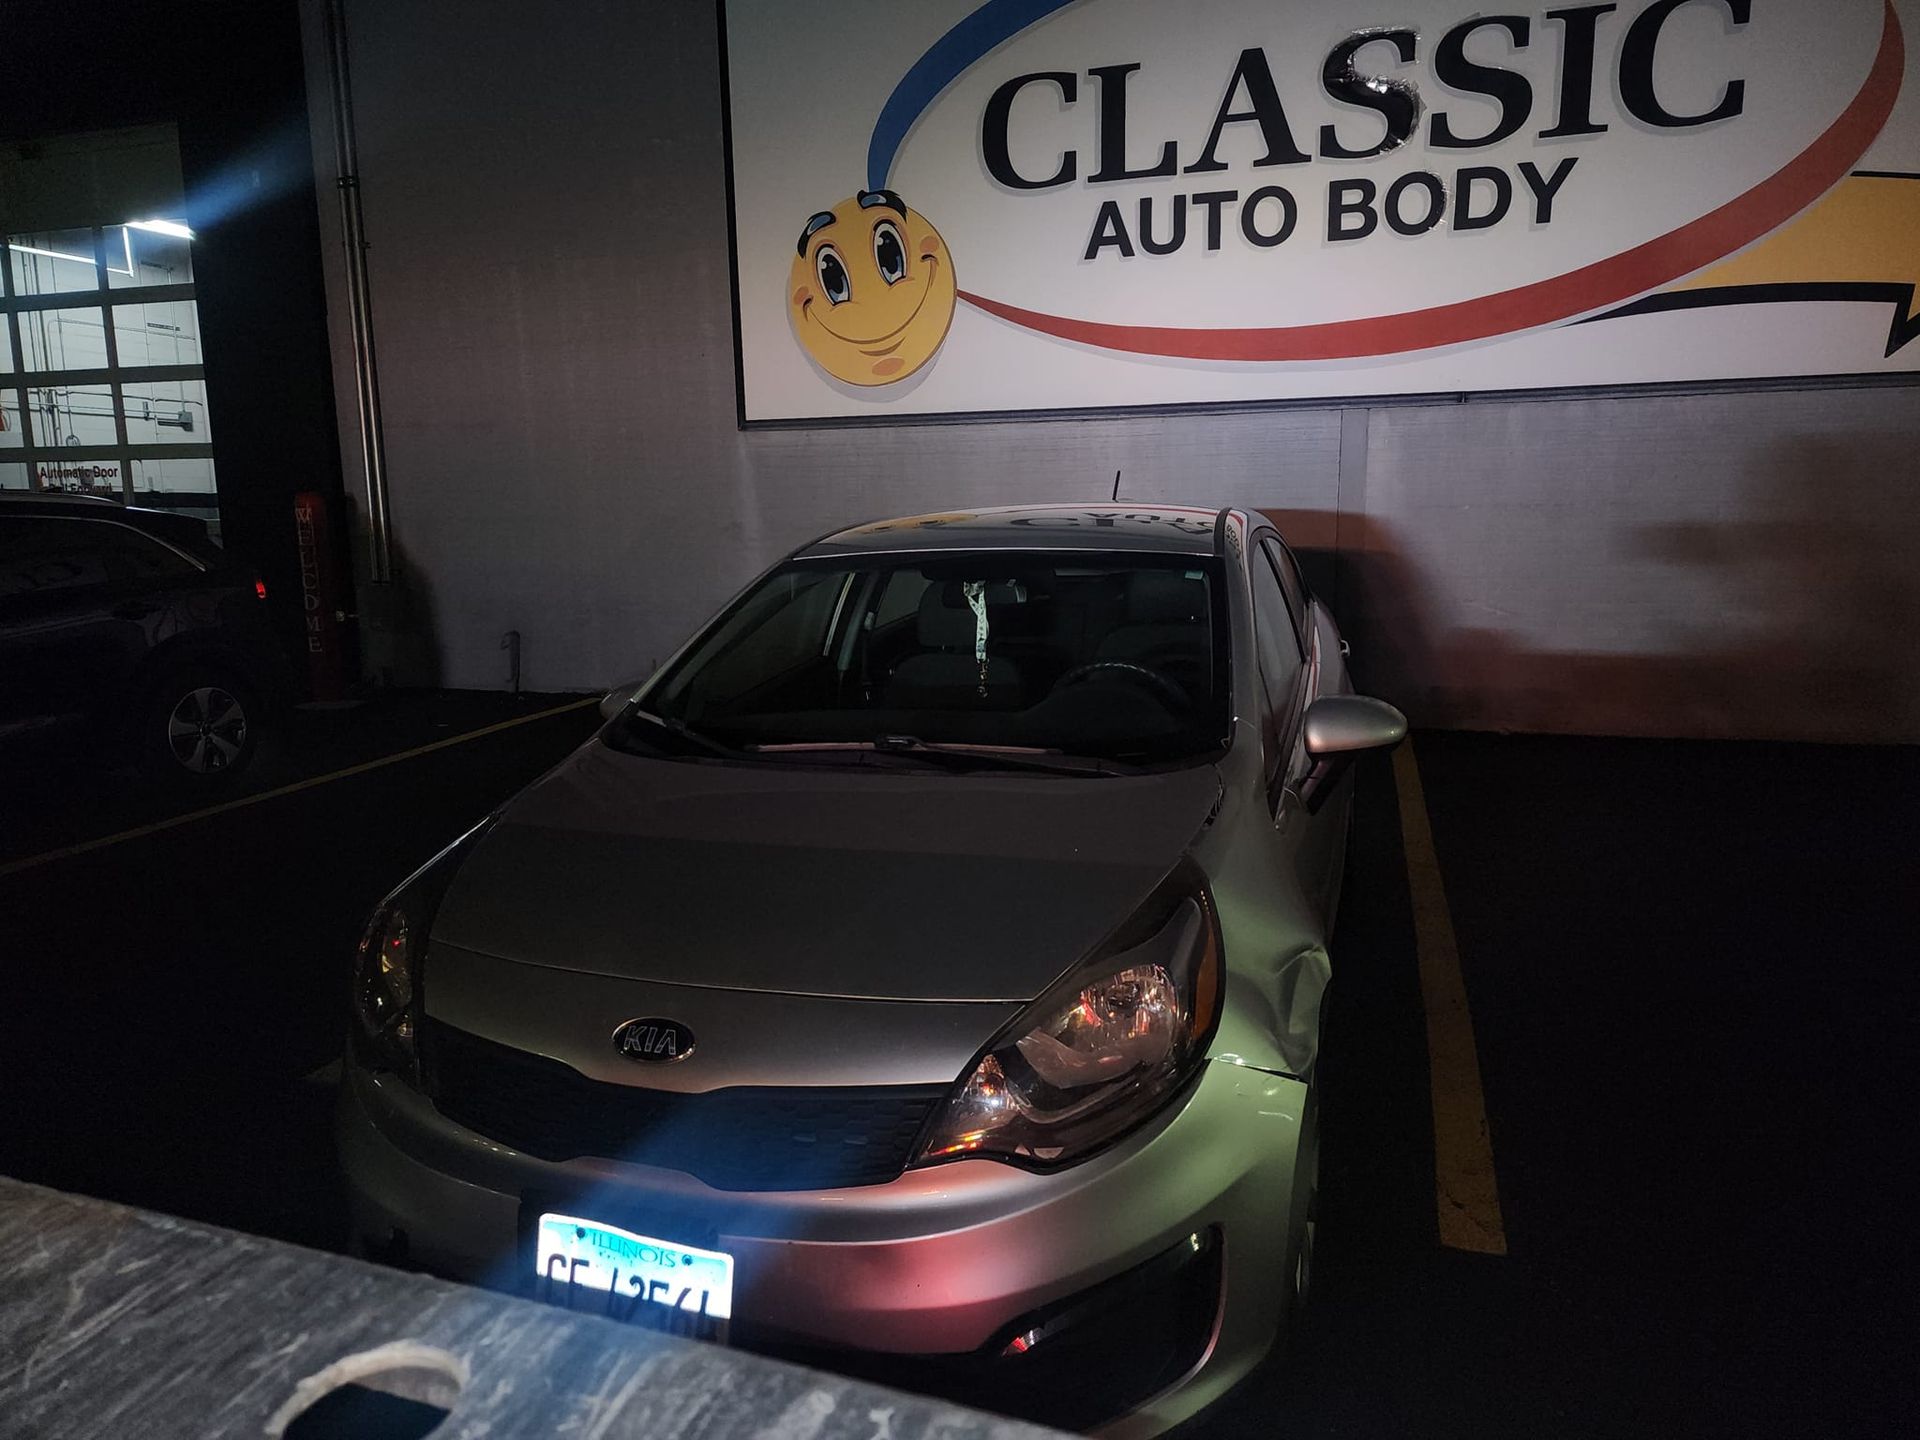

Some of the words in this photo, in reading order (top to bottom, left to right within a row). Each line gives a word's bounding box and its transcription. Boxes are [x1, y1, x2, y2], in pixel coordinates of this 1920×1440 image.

[981, 0, 1752, 192] CLASSIC
[1083, 185, 1298, 260] AUTO
[1327, 156, 1579, 243] BODY
[40, 466, 90, 479] Automatic
[92, 465, 118, 478] Door
[623, 1025, 677, 1056] KIA
[590, 1231, 677, 1268] ILLINOIS
